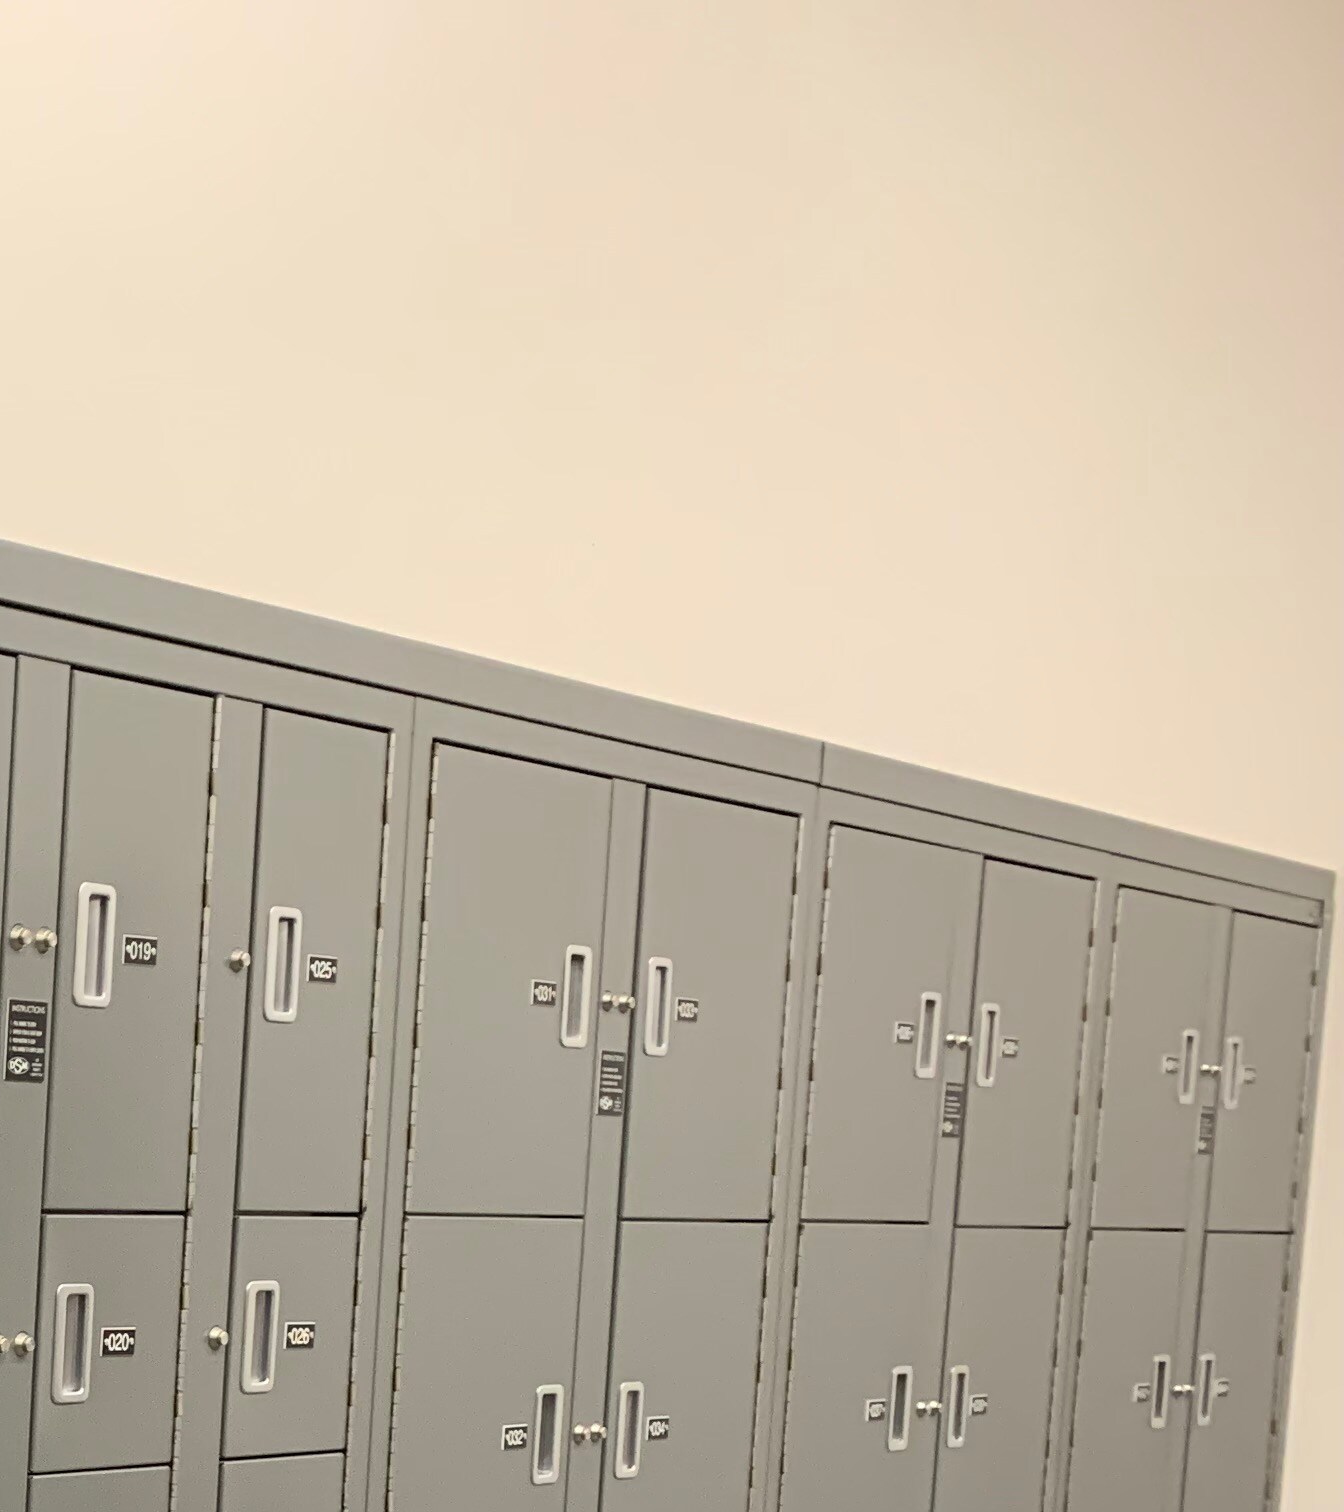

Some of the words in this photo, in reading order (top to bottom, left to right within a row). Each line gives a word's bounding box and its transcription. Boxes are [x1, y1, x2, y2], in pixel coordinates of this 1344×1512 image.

[130, 941, 151, 960] 019
[314, 961, 332, 979] 025
[108, 1333, 129, 1351] 020
[291, 1328, 309, 1345] 026
